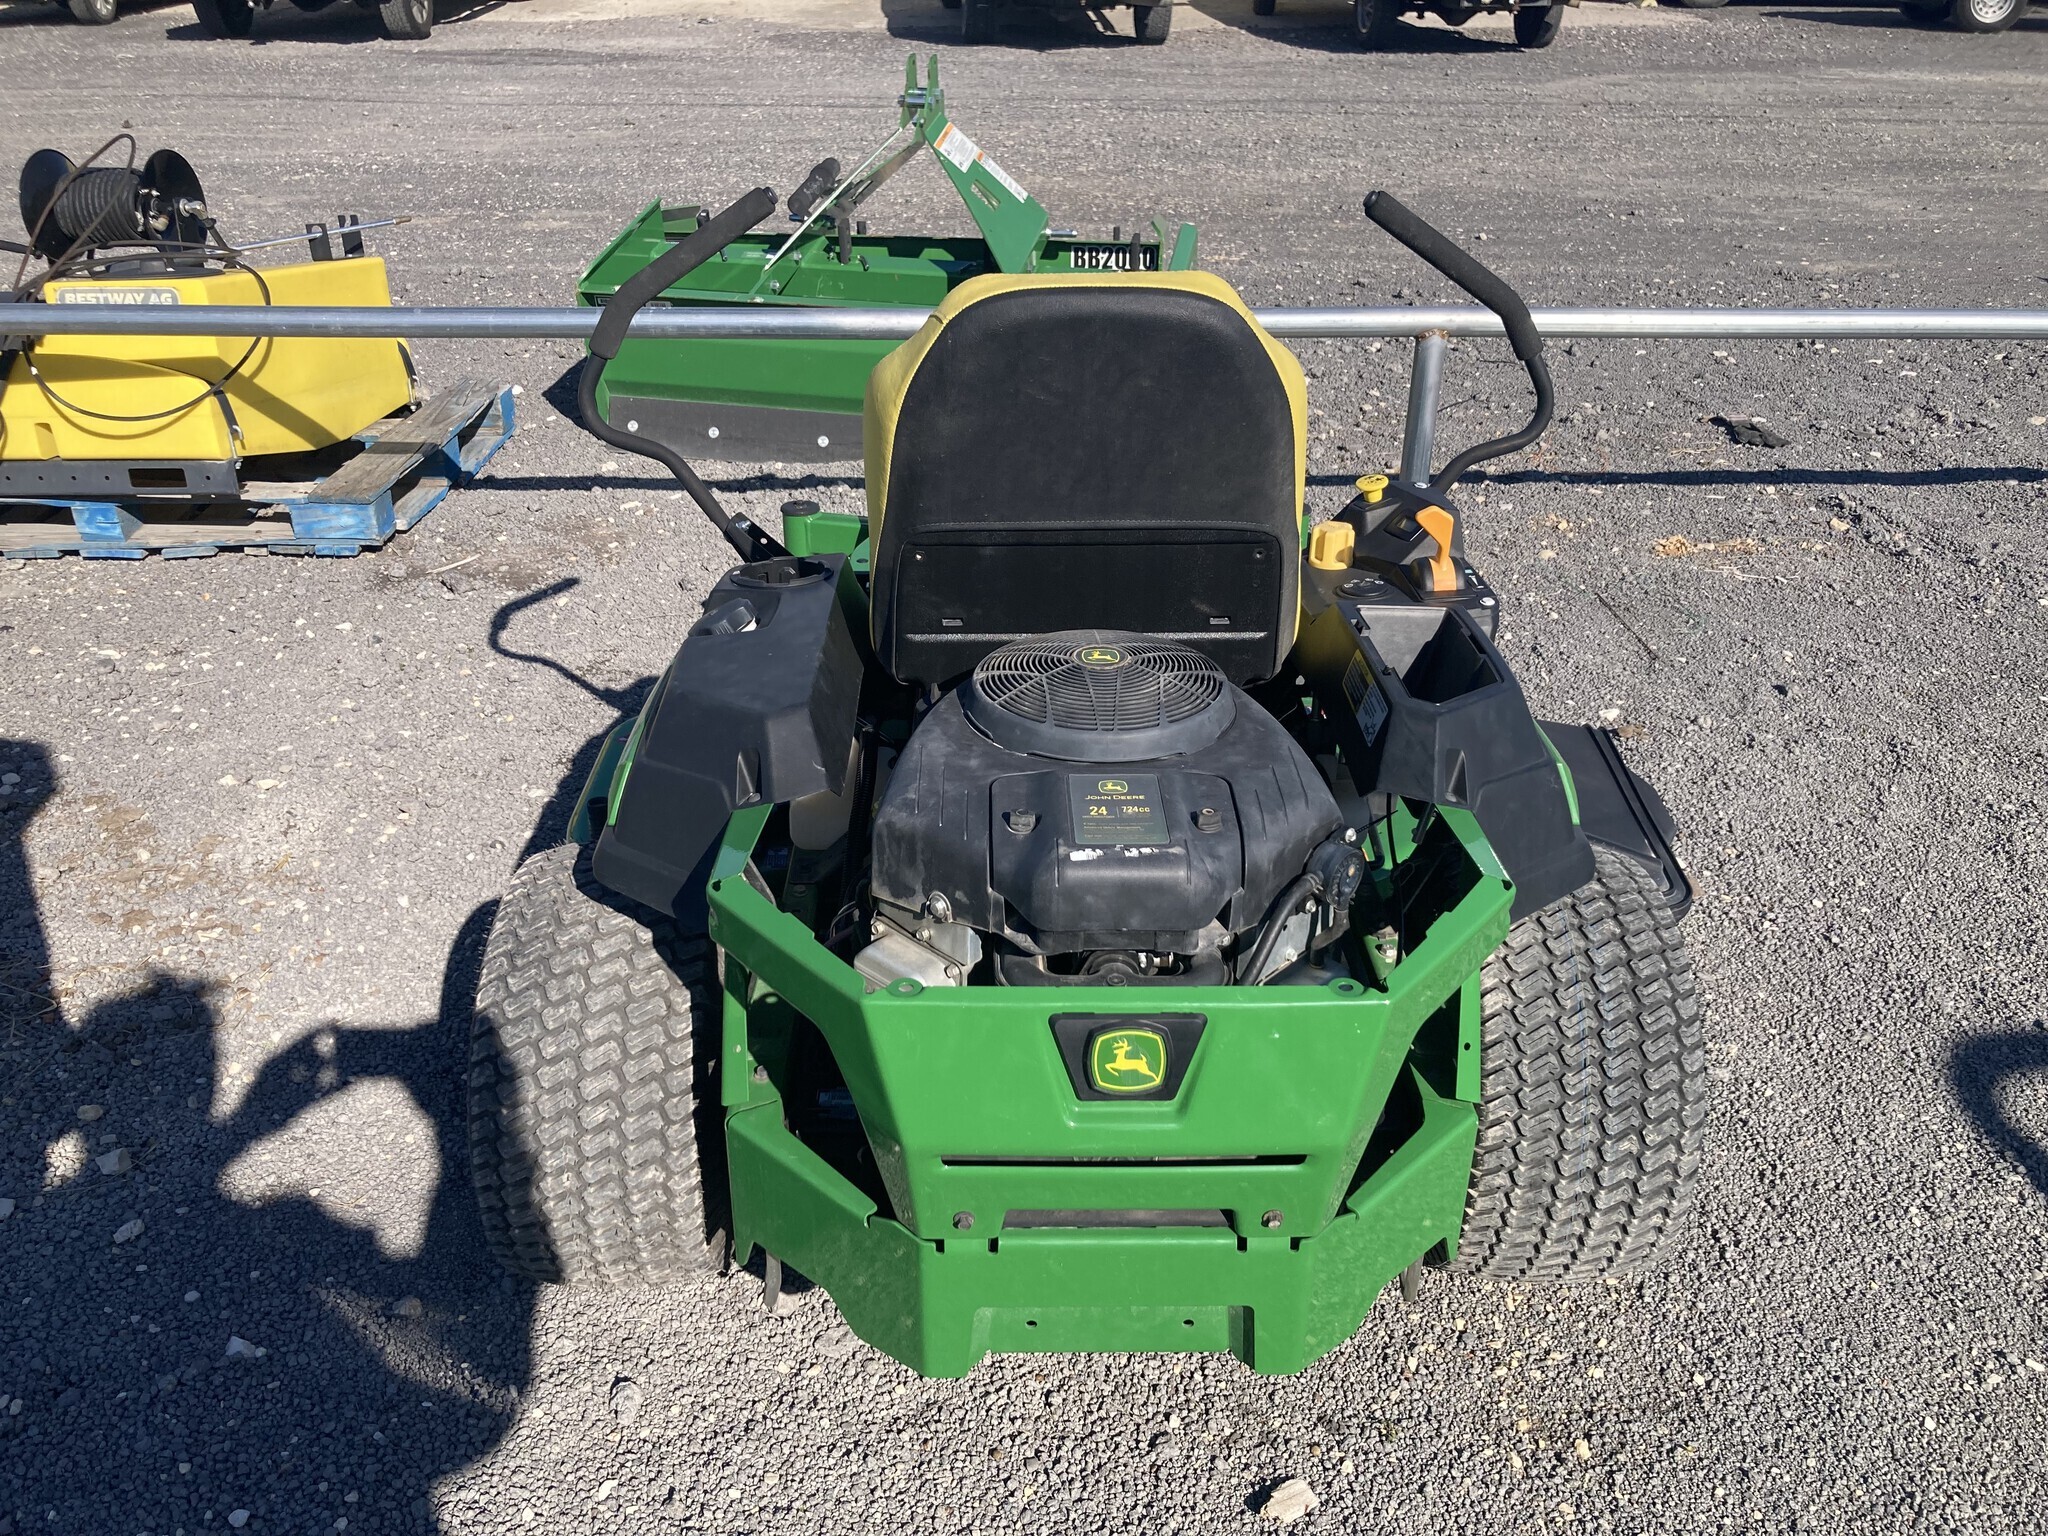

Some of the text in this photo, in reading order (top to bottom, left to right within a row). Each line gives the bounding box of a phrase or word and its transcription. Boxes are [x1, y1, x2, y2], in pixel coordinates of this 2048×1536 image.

[1072, 246, 1155, 270] BB200
[64, 292, 173, 305] BESTWAY AG
[1089, 805, 1108, 816] 24
